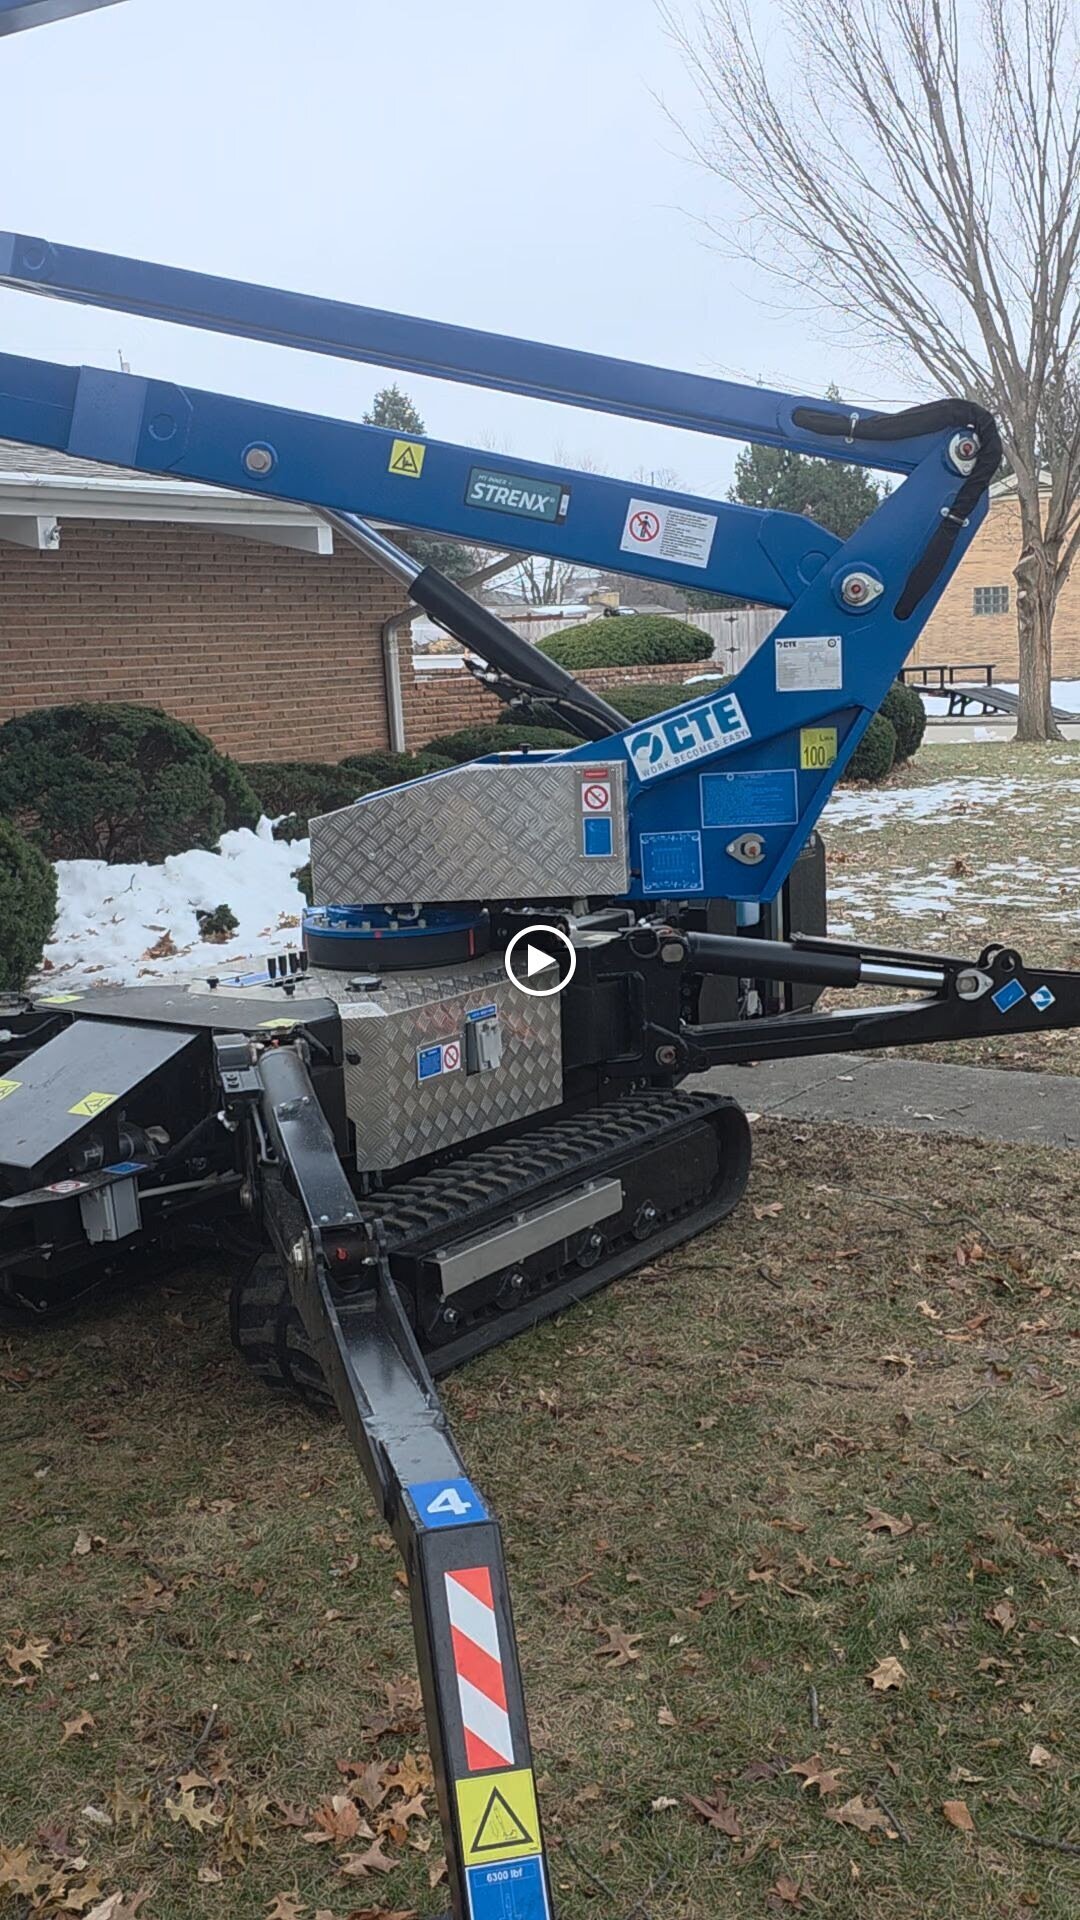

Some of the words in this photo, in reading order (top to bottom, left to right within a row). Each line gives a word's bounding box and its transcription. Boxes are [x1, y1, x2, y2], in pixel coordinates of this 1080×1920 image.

[661, 697, 742, 755] CTE
[641, 760, 670, 778] WORK
[674, 740, 720, 765] BECOMES
[803, 745, 826, 766] 100
[426, 1487, 472, 1515] 4
[486, 1869, 509, 1883] 6300
